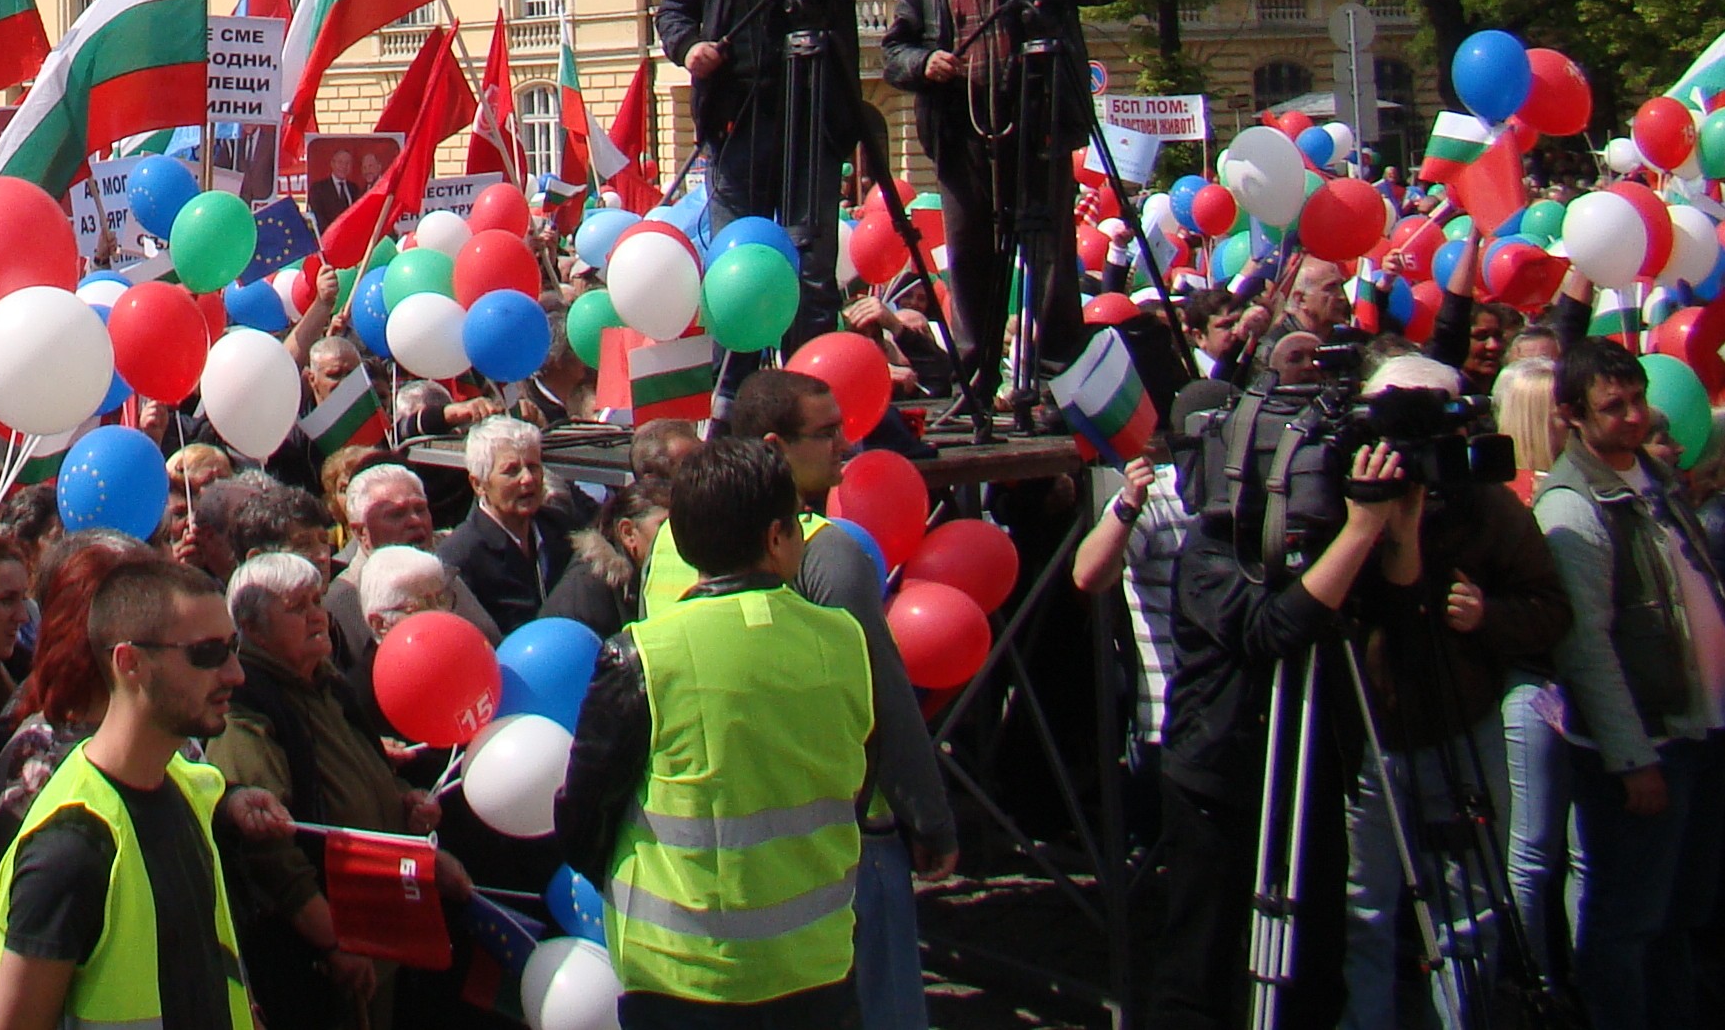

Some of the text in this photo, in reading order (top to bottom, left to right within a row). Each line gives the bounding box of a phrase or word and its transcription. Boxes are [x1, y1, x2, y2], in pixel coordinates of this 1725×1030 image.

[221, 28, 264, 43] СМЕ
[208, 76, 270, 93] ЛЕЩИ
[1112, 100, 1189, 114] БСП ЛОМ:
[423, 183, 474, 199] ЕСТИТ
[80, 214, 96, 235] АЗ
[461, 693, 493, 730] 15
